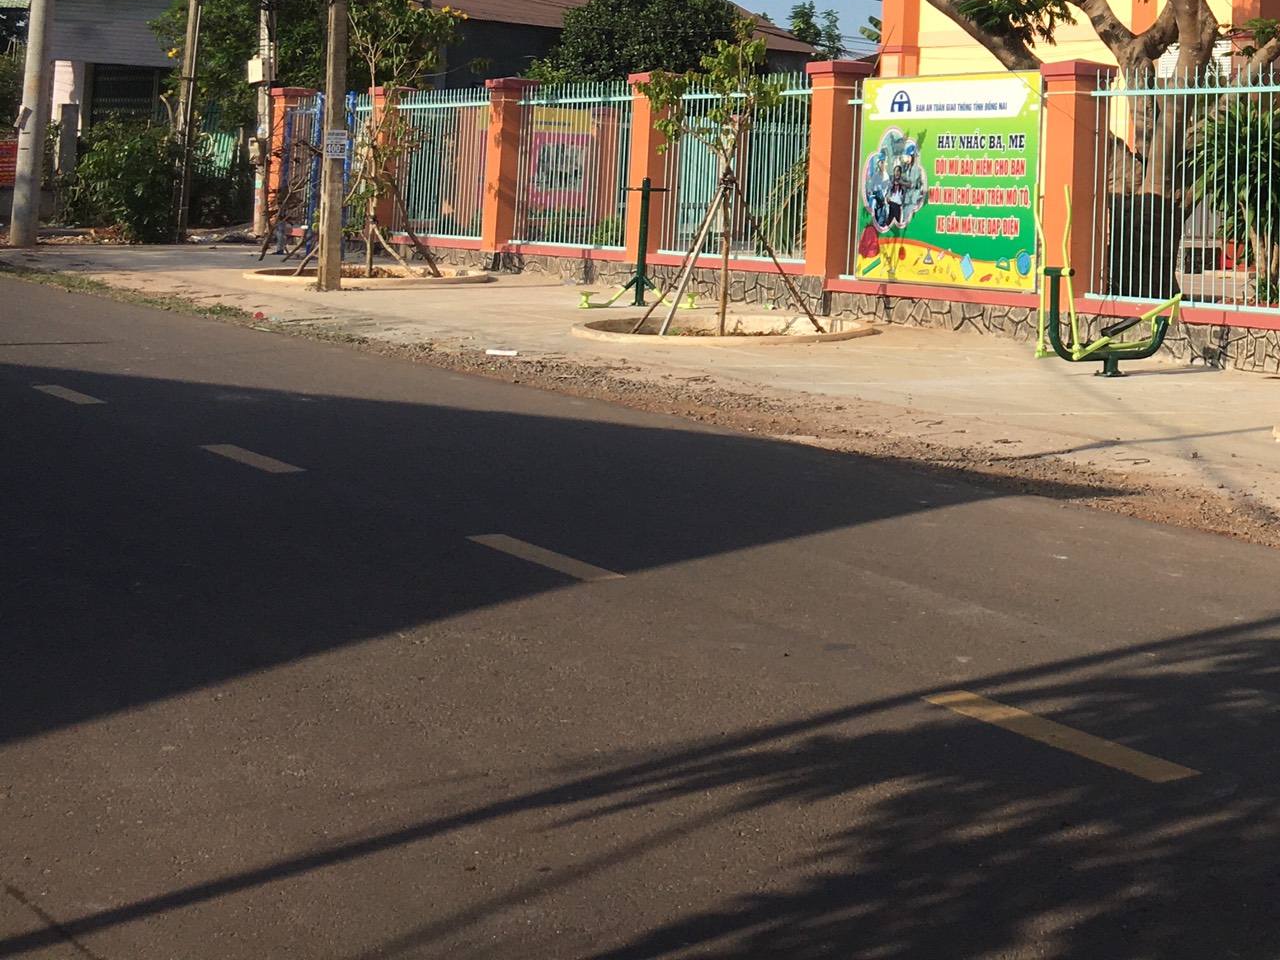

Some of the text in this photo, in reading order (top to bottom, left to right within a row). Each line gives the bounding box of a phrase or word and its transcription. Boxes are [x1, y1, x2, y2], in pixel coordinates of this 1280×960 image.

[938, 129, 1025, 152] HÃY NHẮC BA, MẸ
[994, 159, 1008, 175] CHO
[1010, 159, 1025, 179] BẠN
[943, 187, 955, 204] KHI
[971, 188, 985, 209] BẠN
[987, 186, 1004, 206] TRÊN
[937, 216, 945, 233] XE
